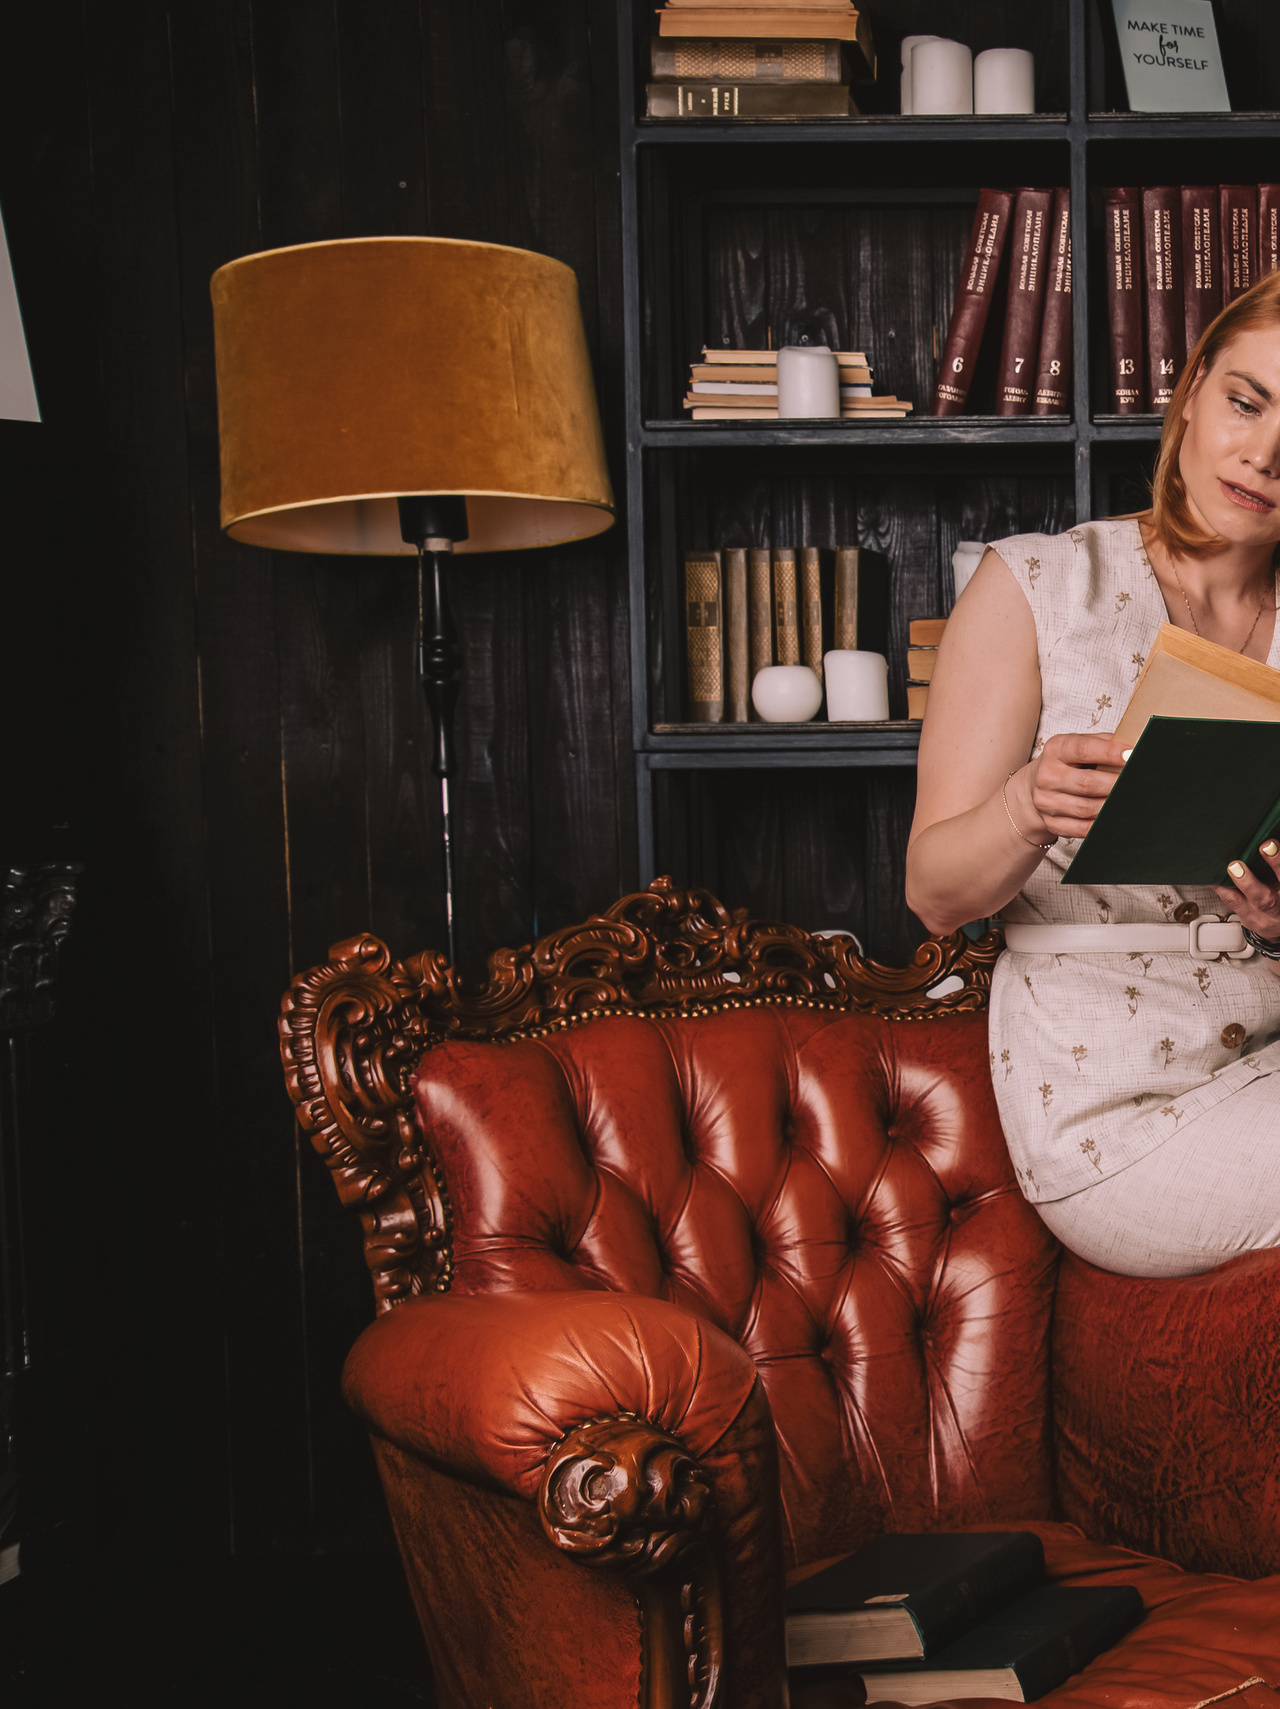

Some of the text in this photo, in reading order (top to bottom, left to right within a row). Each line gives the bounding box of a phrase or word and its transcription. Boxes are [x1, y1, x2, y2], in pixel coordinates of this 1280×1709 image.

[1127, 20, 1205, 38] MAKE TIME
[1159, 34, 1178, 57] for
[1133, 53, 1208, 70] YOURSELF
[966, 212, 989, 291] БОЛЬШАЯ СОВЕТСКАЯ
[976, 214, 999, 293] ЭНЦИКЛОПЕДИЯ
[1019, 209, 1033, 290] БОЛЬШАЯ СОВЕТСКАЯ
[1028, 211, 1042, 291] ЭНЦИКЛОПЕДИЯ
[1054, 256, 1064, 292] БОЛЬШАЯ
[1059, 211, 1068, 254] СОВЕТСКАЯ
[1113, 209, 1121, 252] СОВЕТСКАЯ
[1122, 209, 1132, 290] ЭНЦИКЛОПЕДИЯ
[1154, 209, 1163, 290] БОЛЬШАЯ СОВЕТСКАЯ
[1163, 209, 1172, 290] ЭНЦИКЛОПЕДИЯ
[1203, 208, 1212, 290] ЭНЦИКЛОПЕДИЯ
[1241, 208, 1250, 288] ЭНЦИКЛОПЕДИЯ
[1194, 253, 1202, 288] БОЛЬШАЯ
[952, 356, 964, 373] 6
[1014, 357, 1024, 374] 7
[1049, 359, 1061, 376] 8
[1119, 358, 1135, 375] 13
[1160, 358, 1174, 375] 14
